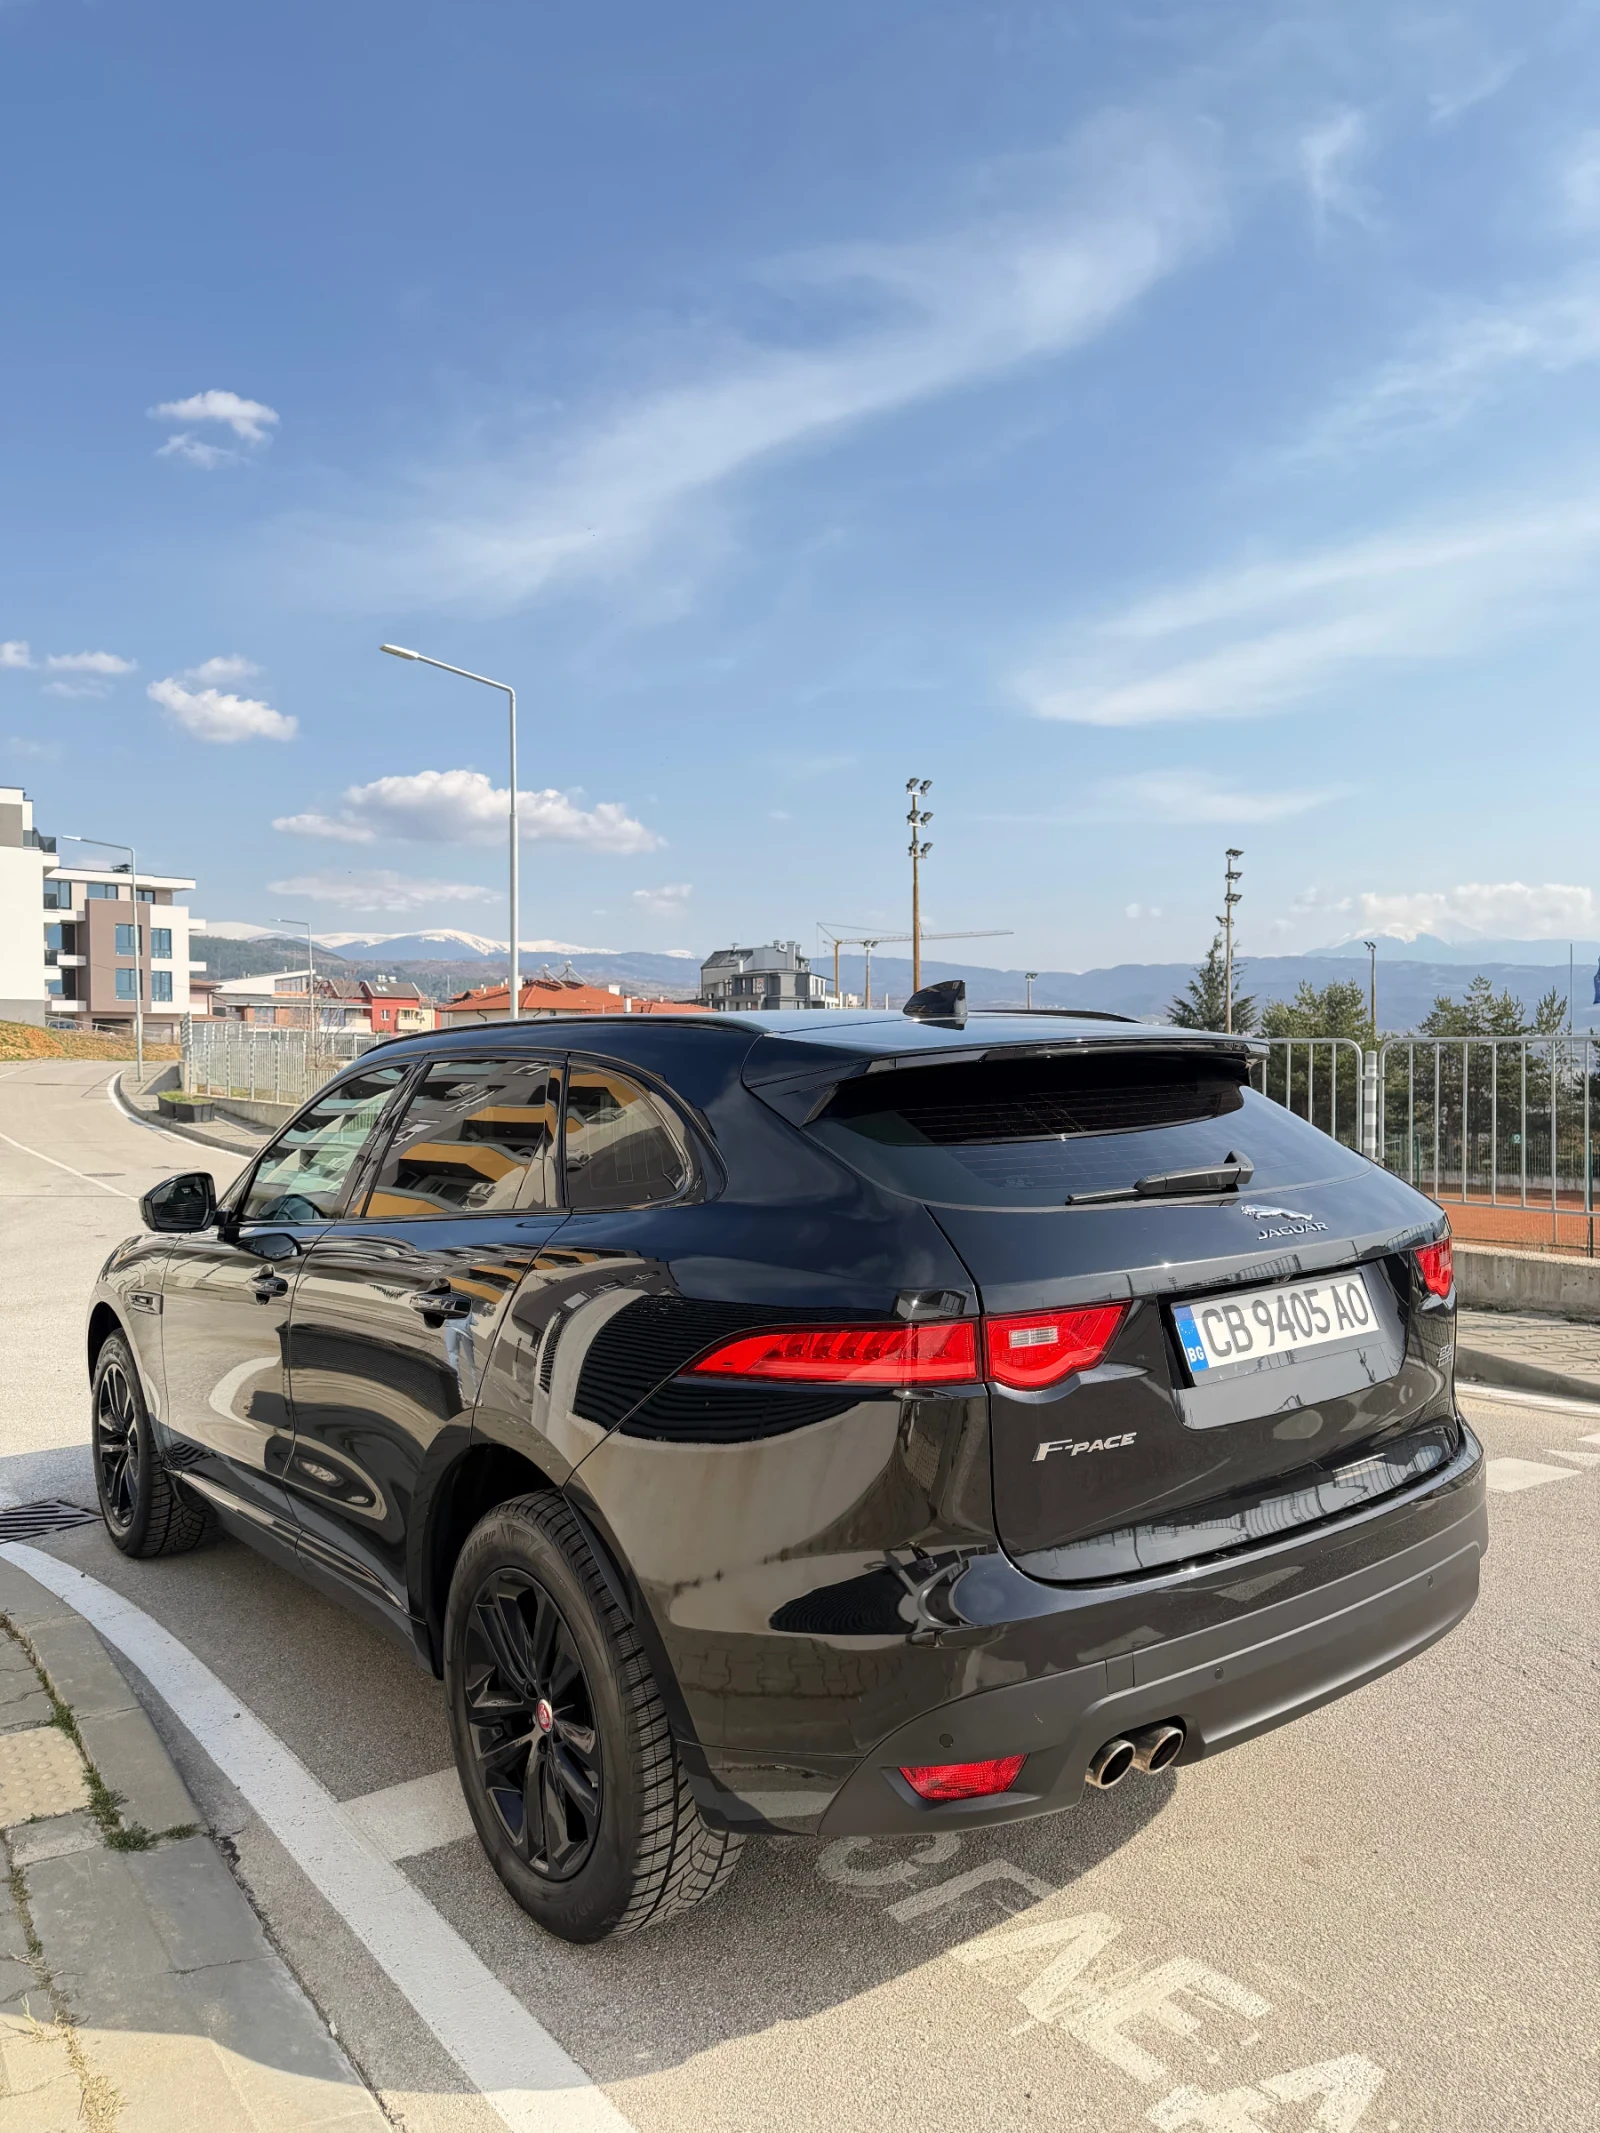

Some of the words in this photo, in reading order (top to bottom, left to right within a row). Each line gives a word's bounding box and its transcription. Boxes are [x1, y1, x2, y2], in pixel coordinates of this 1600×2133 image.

[1256, 1221, 1329, 1240] JAGUAR
[1202, 1303, 1254, 1358] CB
[1253, 1289, 1331, 1347] 9405
[1187, 1345, 1205, 1363] BG
[1032, 1431, 1138, 1462] F-PACE
